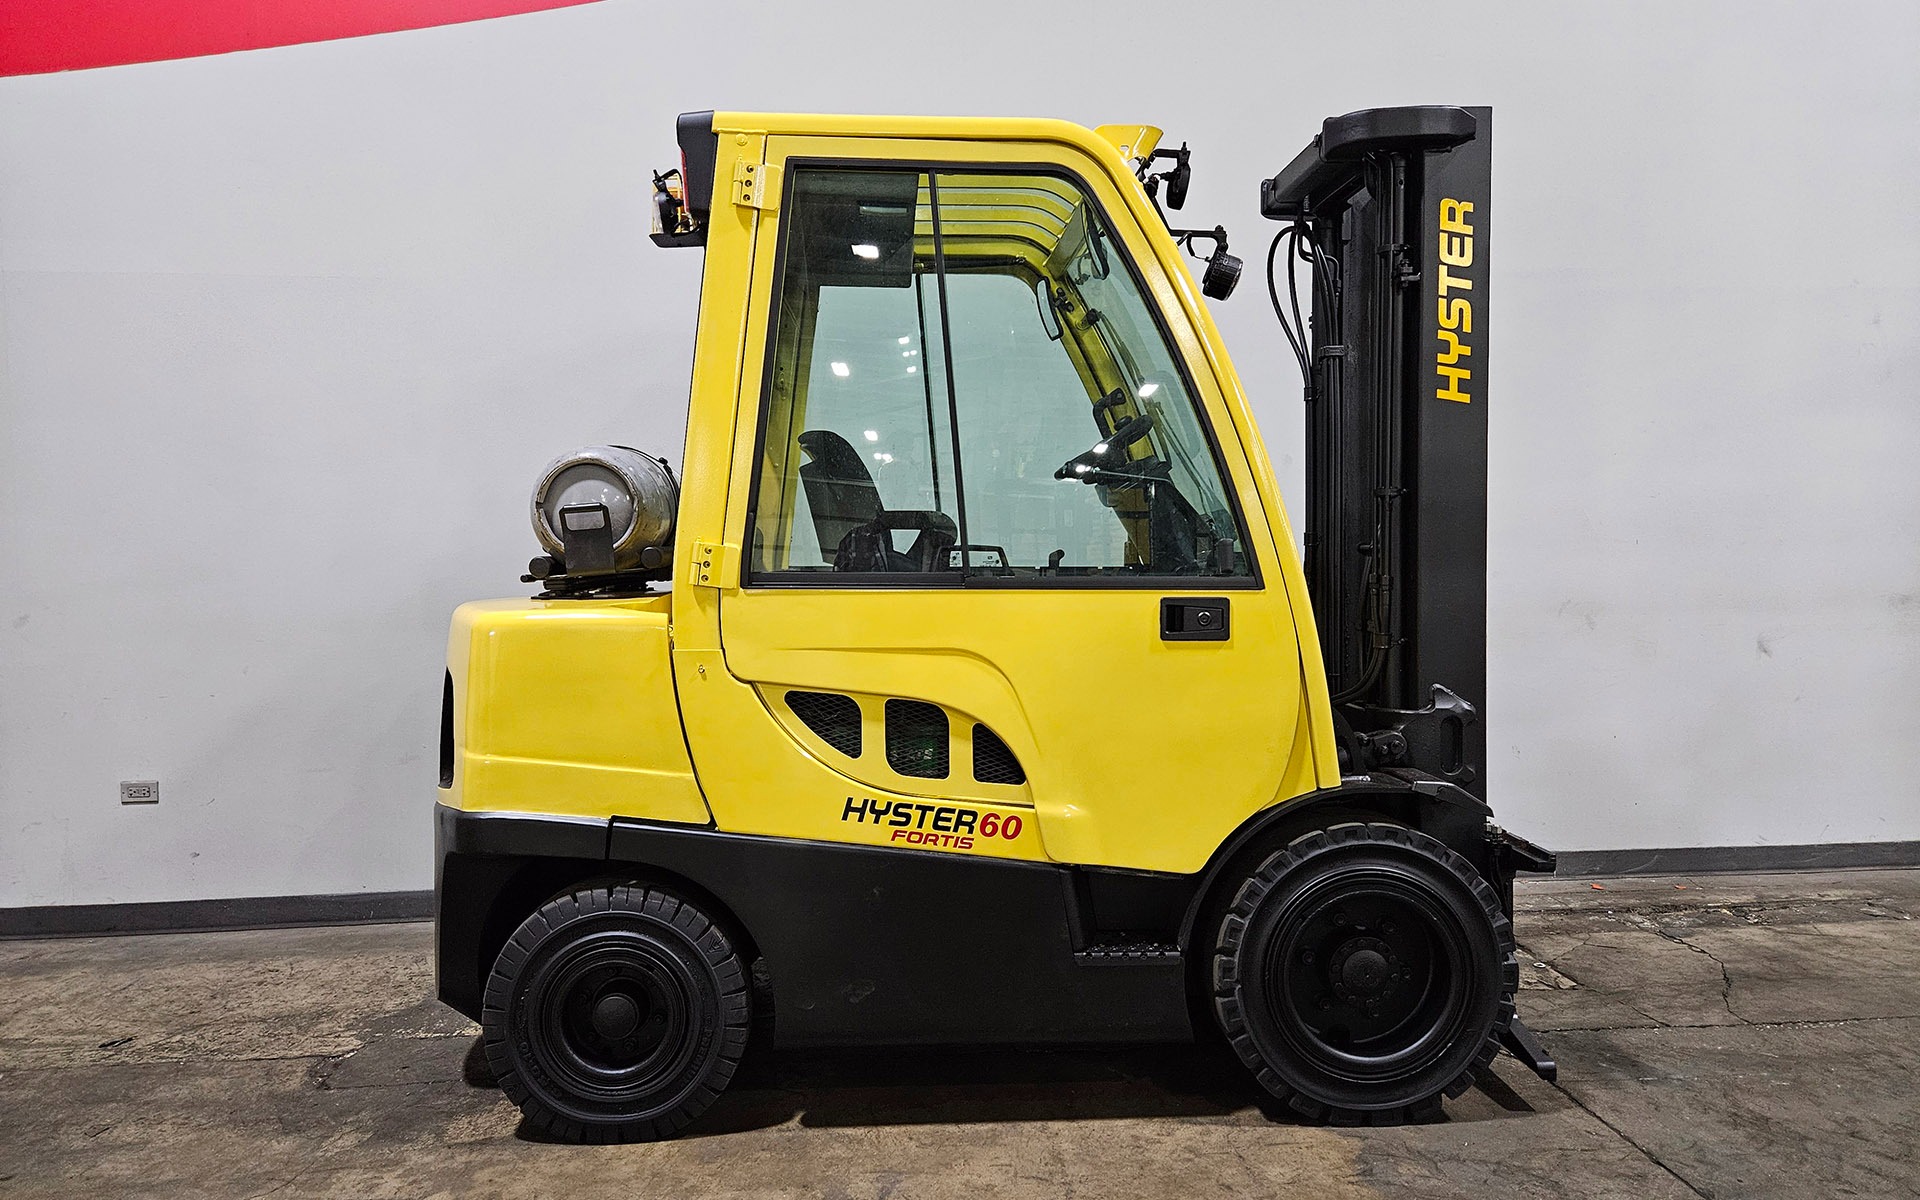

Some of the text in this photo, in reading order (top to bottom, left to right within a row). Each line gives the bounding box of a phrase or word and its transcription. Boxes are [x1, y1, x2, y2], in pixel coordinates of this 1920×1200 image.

[1436, 198, 1474, 404] HYSTER
[841, 797, 1023, 840] HYSTER 60
[890, 829, 975, 850] FORTIS
